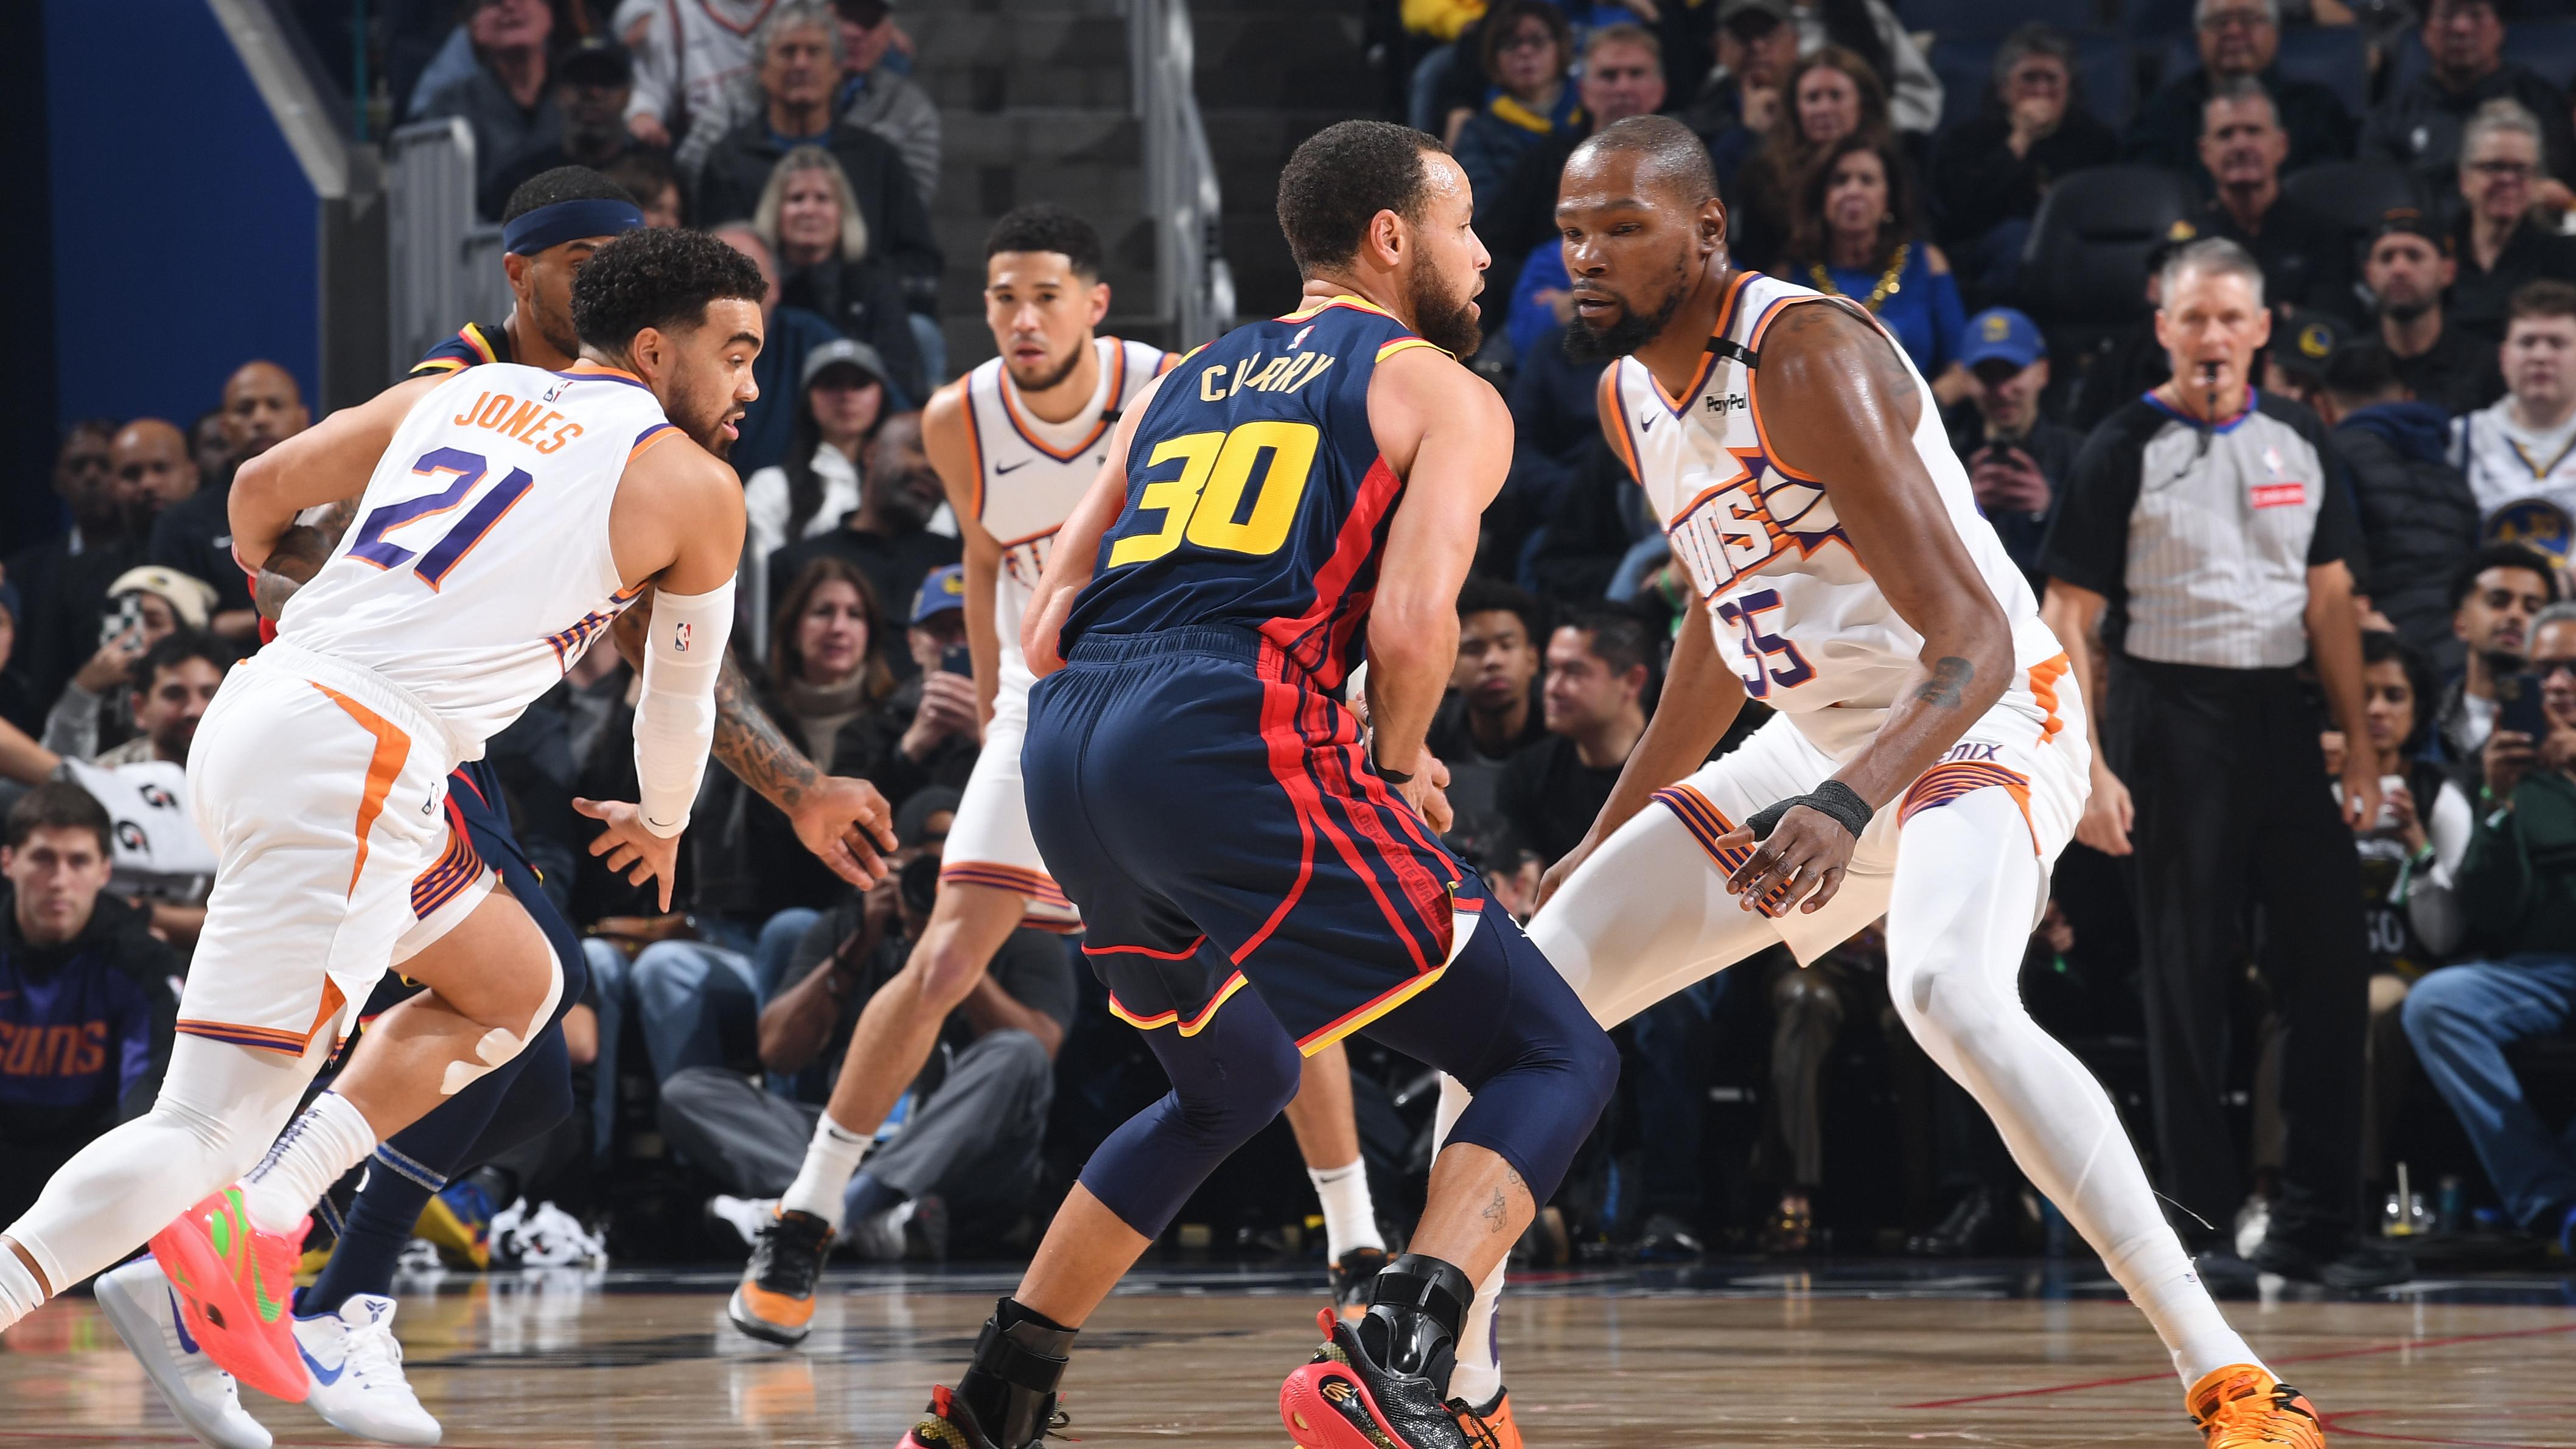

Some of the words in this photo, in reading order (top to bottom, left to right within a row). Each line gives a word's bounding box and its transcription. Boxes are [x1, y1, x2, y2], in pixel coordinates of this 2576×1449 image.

[453, 391, 584, 455] JONES
[1200, 351, 1336, 402] CURRY
[1706, 392, 1747, 416] PayPal
[343, 446, 534, 594] 21
[1108, 420, 1320, 569] 30
[1670, 488, 1772, 598] UNS
[1715, 588, 1818, 700] 35
